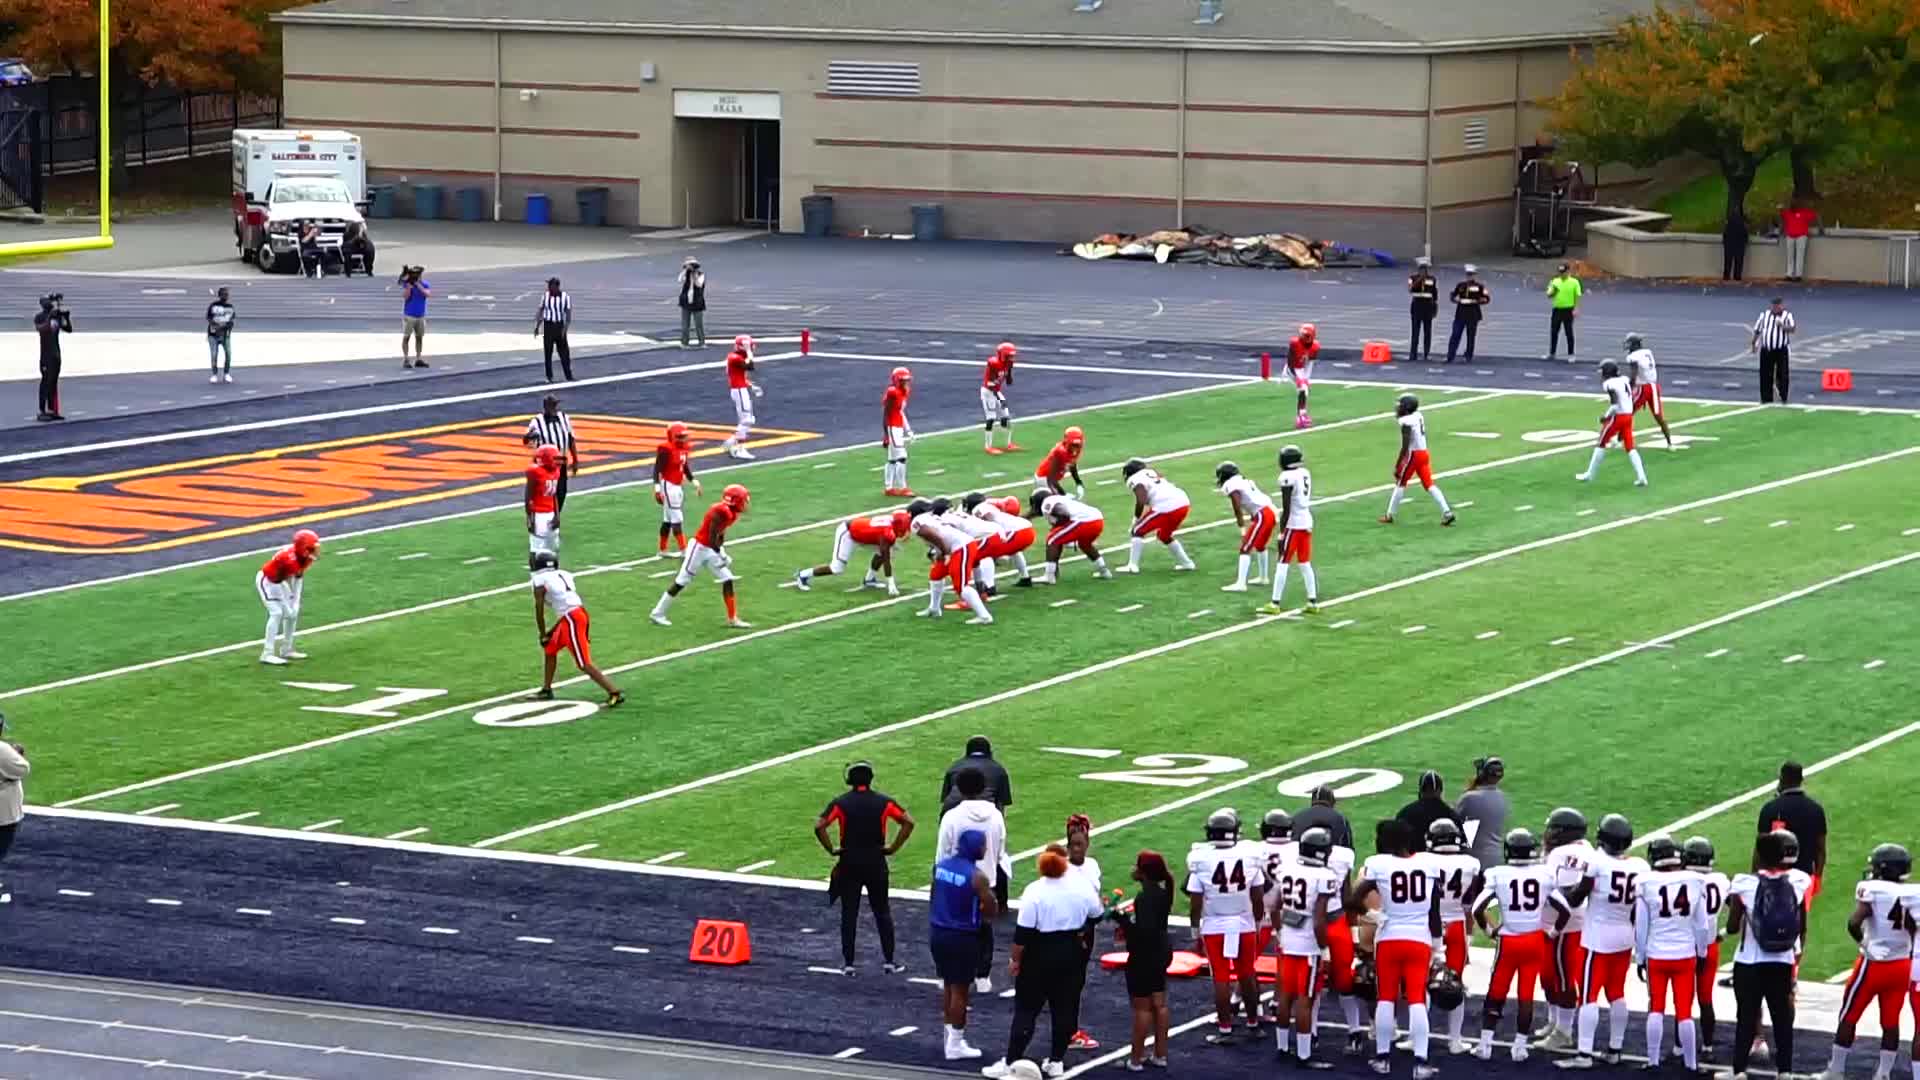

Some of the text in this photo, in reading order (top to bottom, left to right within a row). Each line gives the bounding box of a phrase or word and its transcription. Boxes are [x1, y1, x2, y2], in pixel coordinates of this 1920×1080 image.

[1828, 373, 1845, 386] 10
[1303, 476, 1310, 497] 5
[557, 573, 572, 592] 1
[1211, 859, 1247, 894] 44
[1282, 875, 1308, 911] 23
[1391, 869, 1426, 904] 80
[1508, 878, 1540, 912] 19
[1658, 884, 1691, 918] 14
[699, 925, 735, 958] 20
